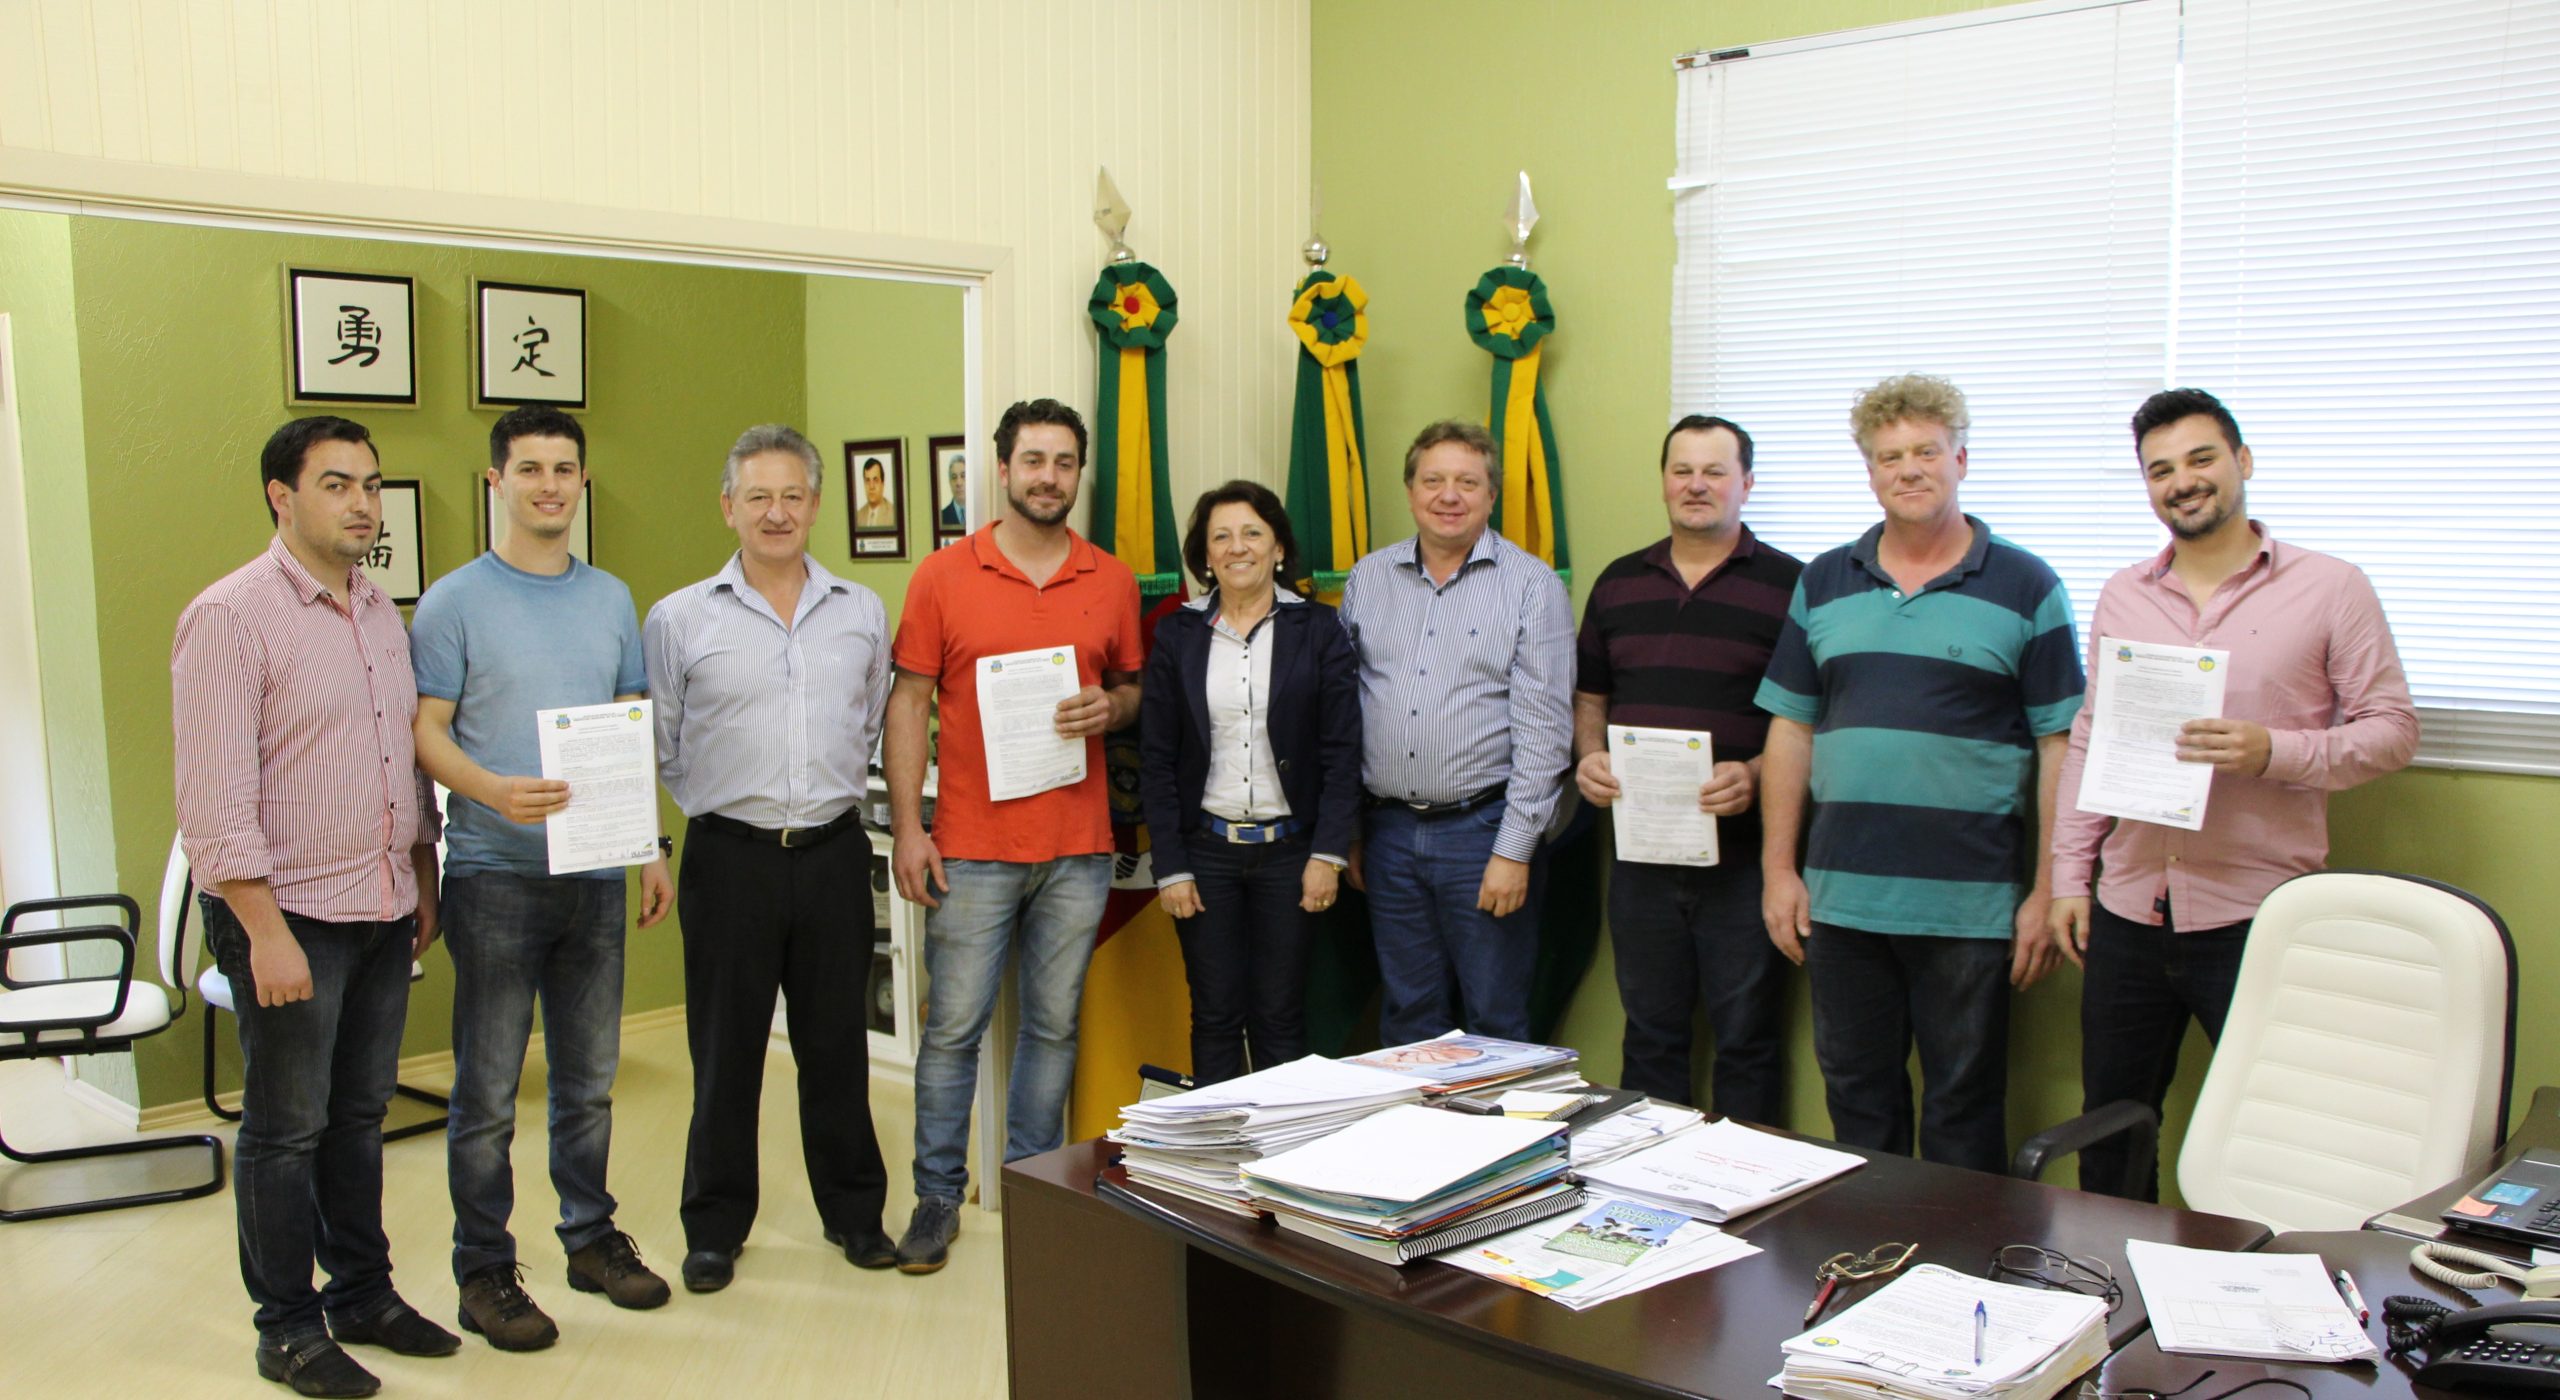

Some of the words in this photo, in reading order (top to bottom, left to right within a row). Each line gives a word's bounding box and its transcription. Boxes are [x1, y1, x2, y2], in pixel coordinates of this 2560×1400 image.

[328, 306, 381, 367] 勇
[512, 316, 554, 376] 定
[1611, 1205, 1679, 1225] ATIVIDADE
